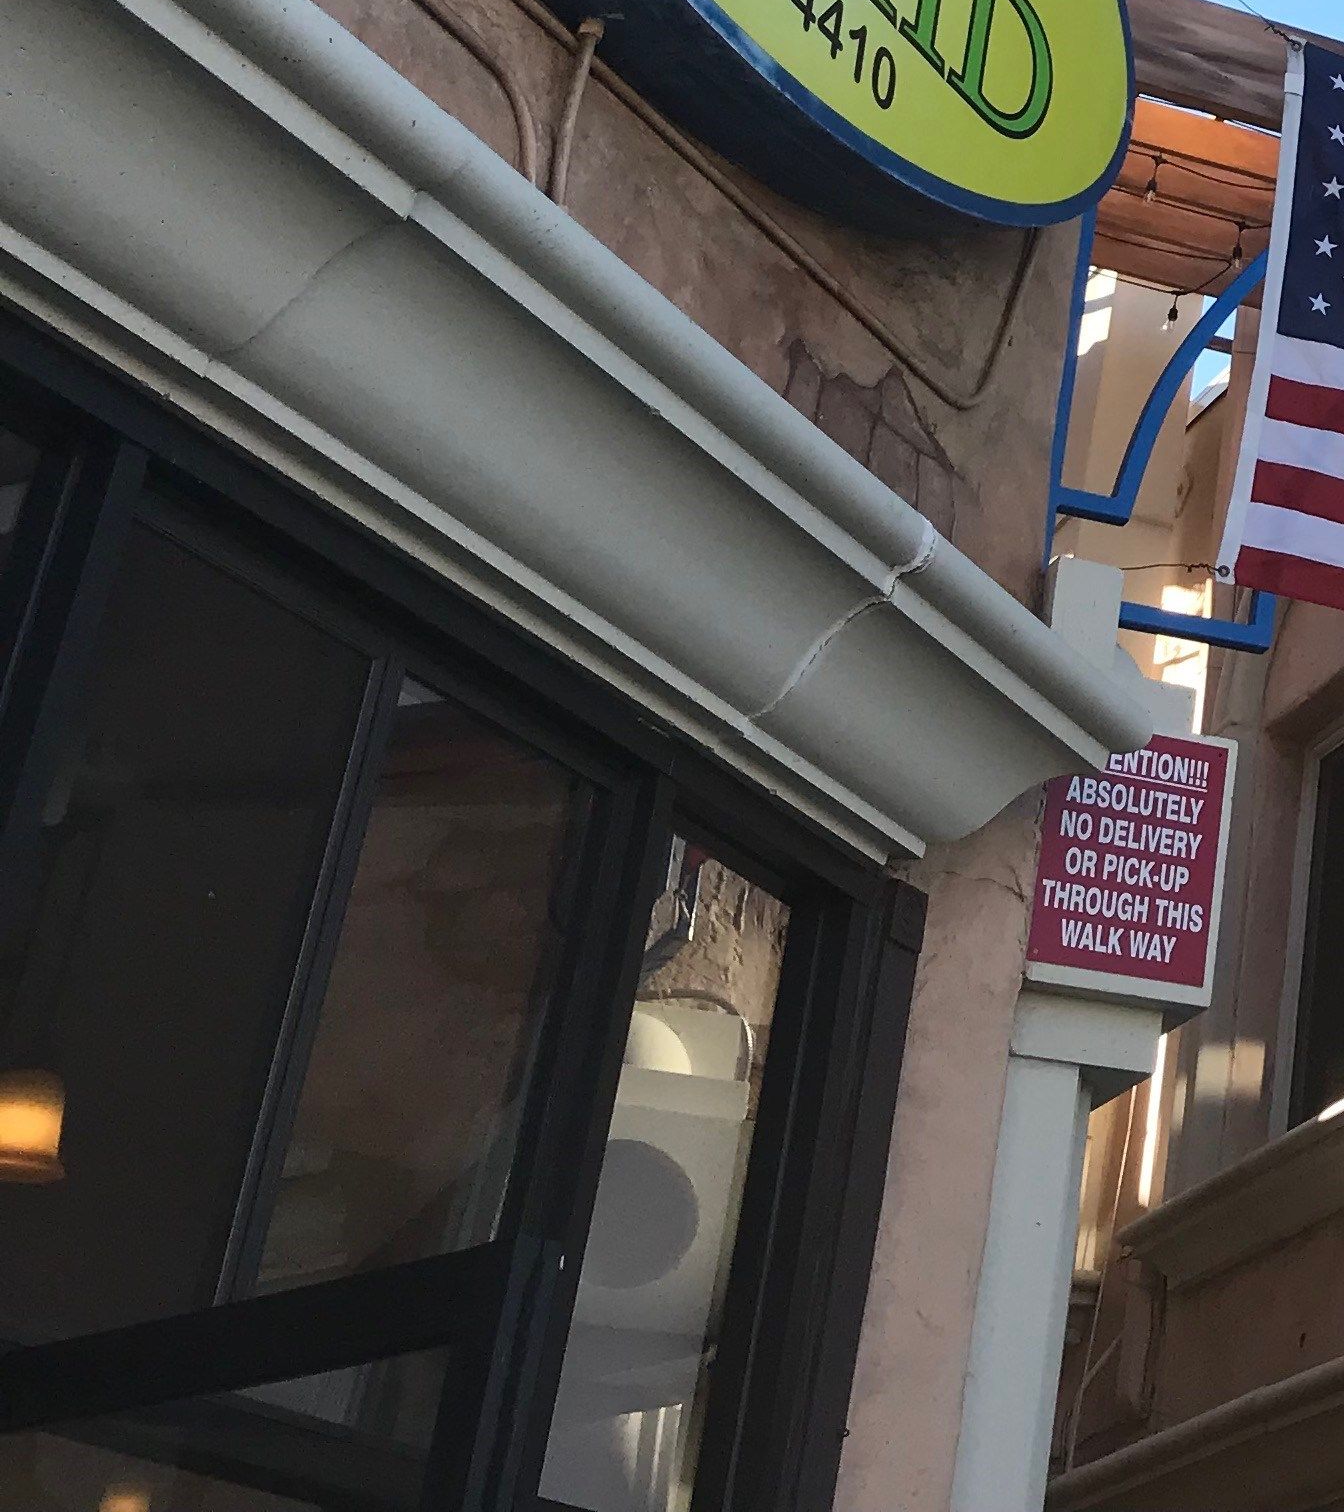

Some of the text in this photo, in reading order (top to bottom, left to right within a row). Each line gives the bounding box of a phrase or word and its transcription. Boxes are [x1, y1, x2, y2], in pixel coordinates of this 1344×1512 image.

[1109, 749, 1209, 788] ENTION!!!
[1066, 775, 1205, 825] ABSOLUTELY
[1060, 810, 1203, 860] NO DELIVERY
[1065, 846, 1190, 893] OR PICK-UP
[1042, 879, 1204, 933] THROUGH THIS
[1061, 918, 1178, 964] WALK WAY
